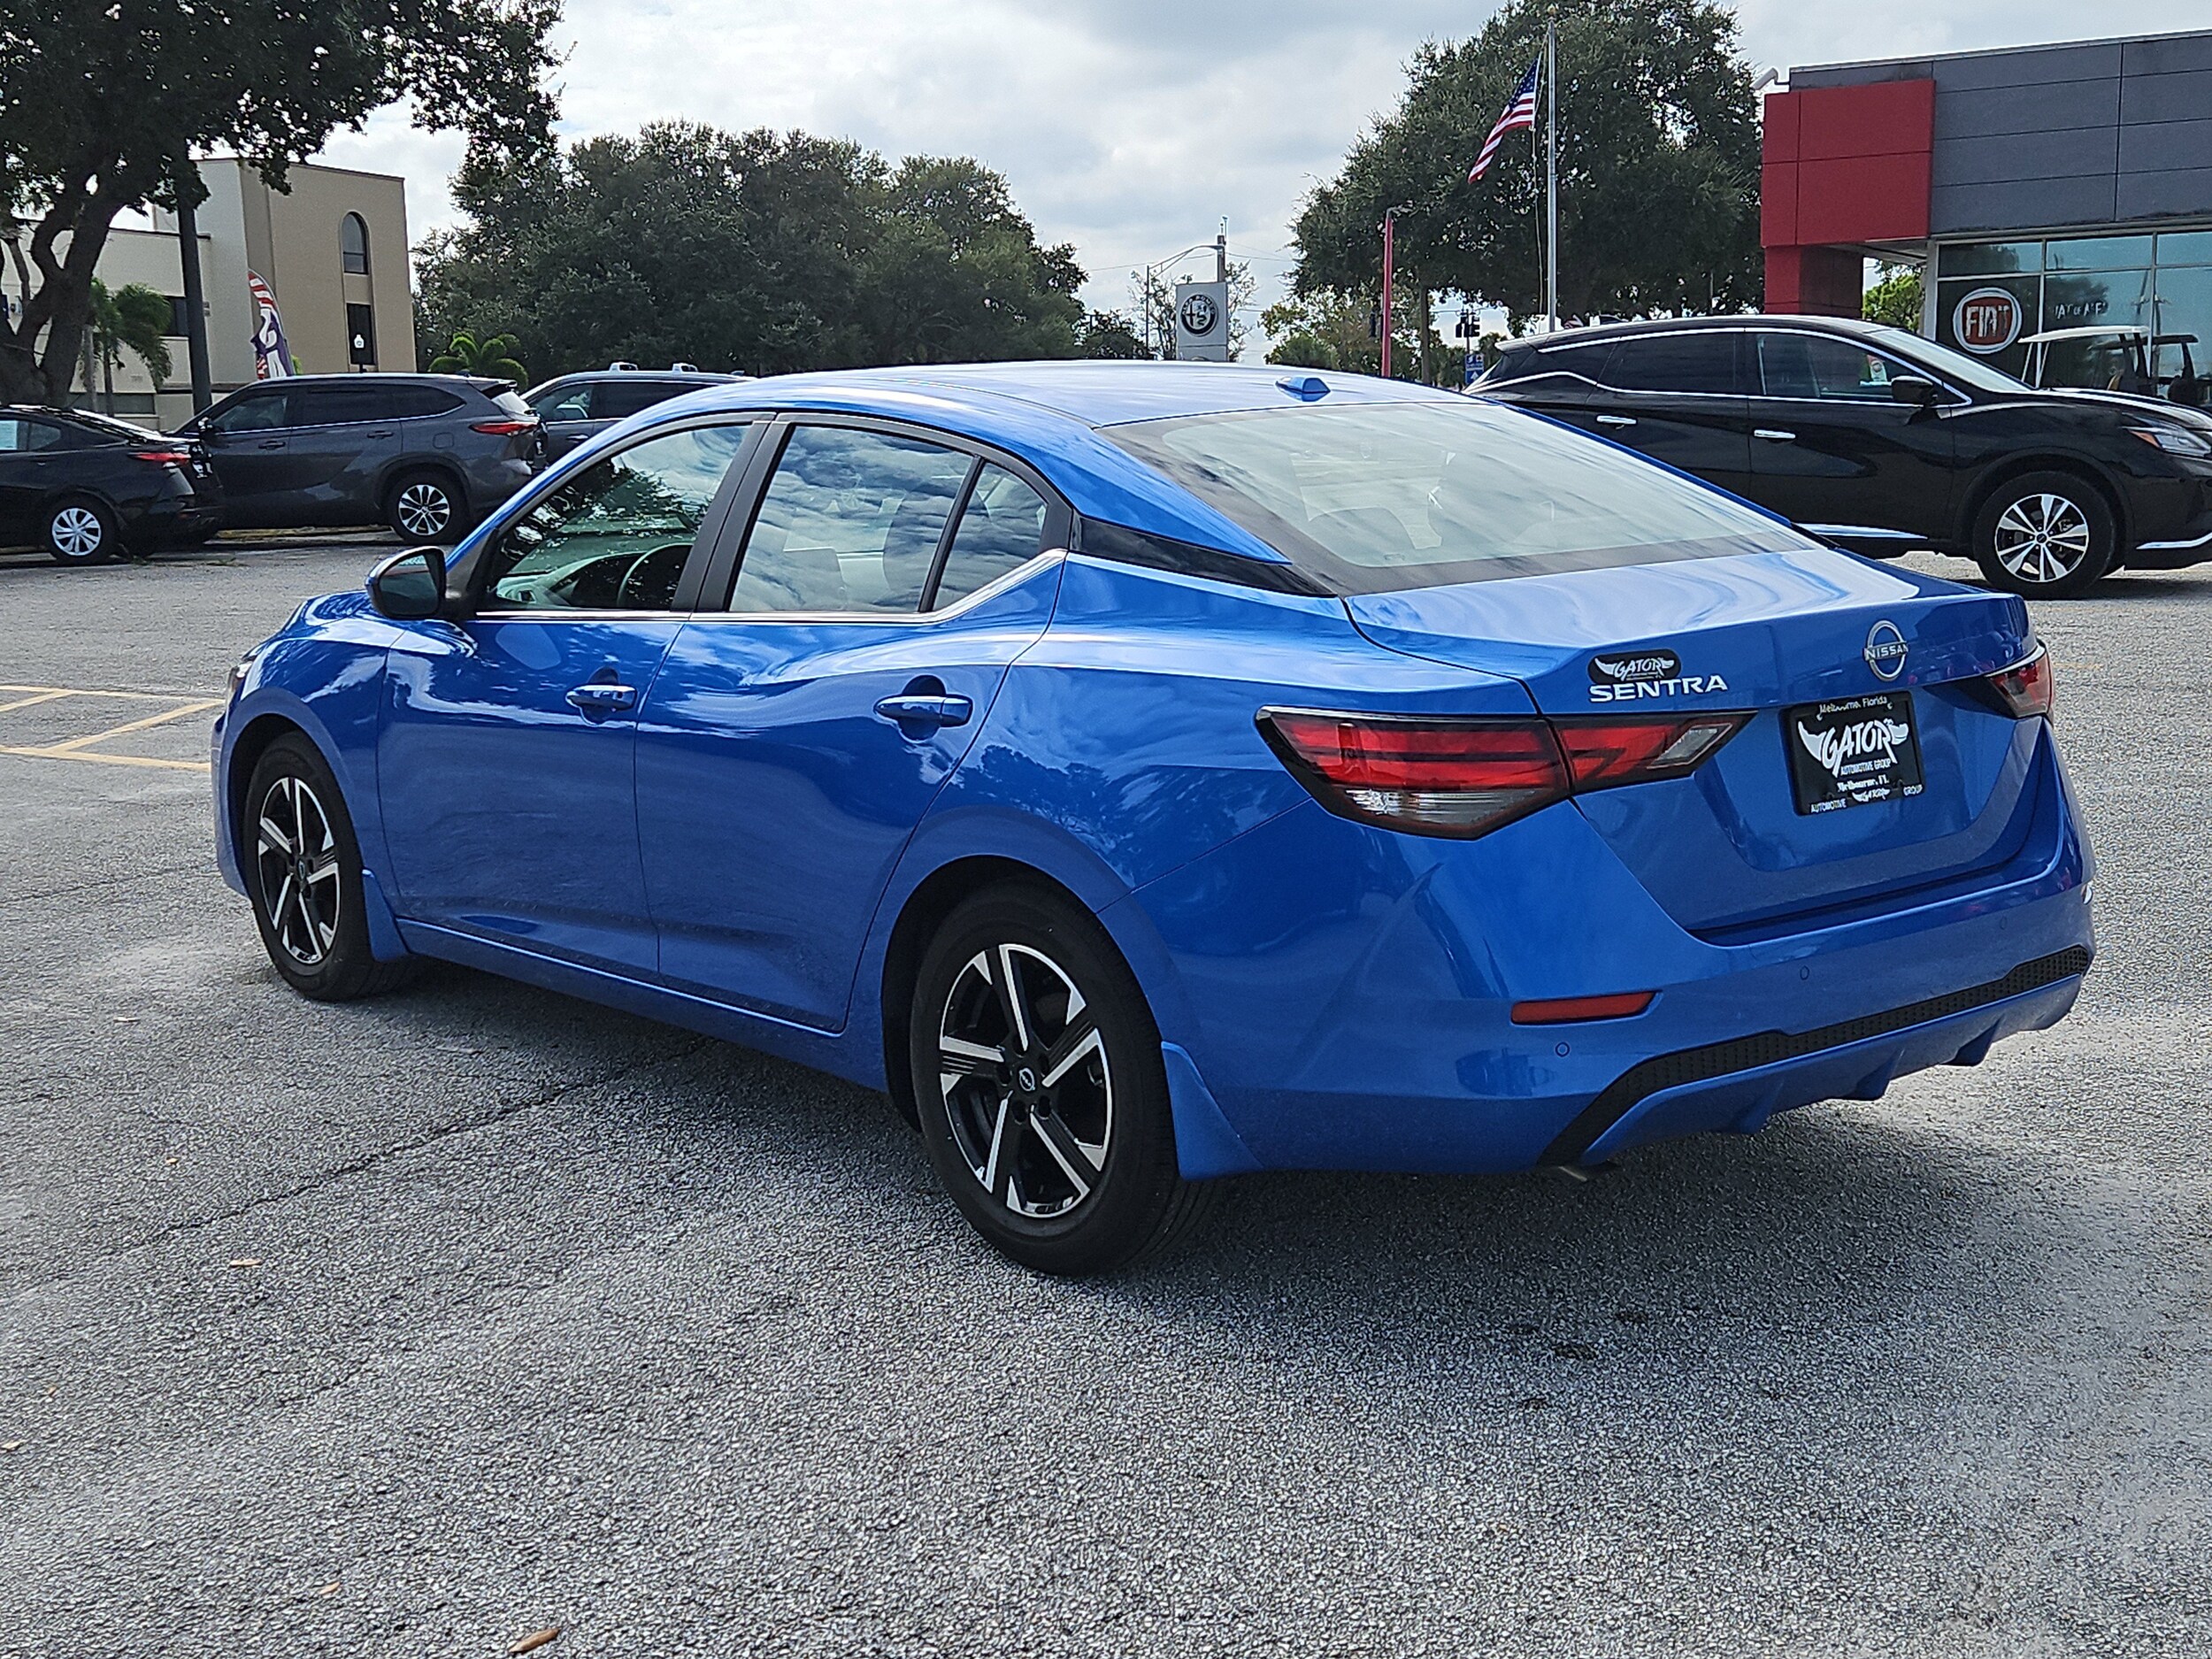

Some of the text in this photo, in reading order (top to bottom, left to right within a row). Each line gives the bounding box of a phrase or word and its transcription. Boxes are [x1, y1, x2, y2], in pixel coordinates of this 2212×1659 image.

[1965, 305, 2010, 339] FIAT
[1864, 643, 1909, 661] NISSAN
[1614, 658, 1664, 681] GATOR
[1589, 675, 1728, 702] SENTRA
[1862, 695, 1888, 708] Florida
[1823, 719, 1898, 778] GATOR
[1874, 757, 1892, 770] GROUP
[1810, 798, 1847, 813] AUTOMOTIVE
[1903, 784, 1923, 796] GROUP
